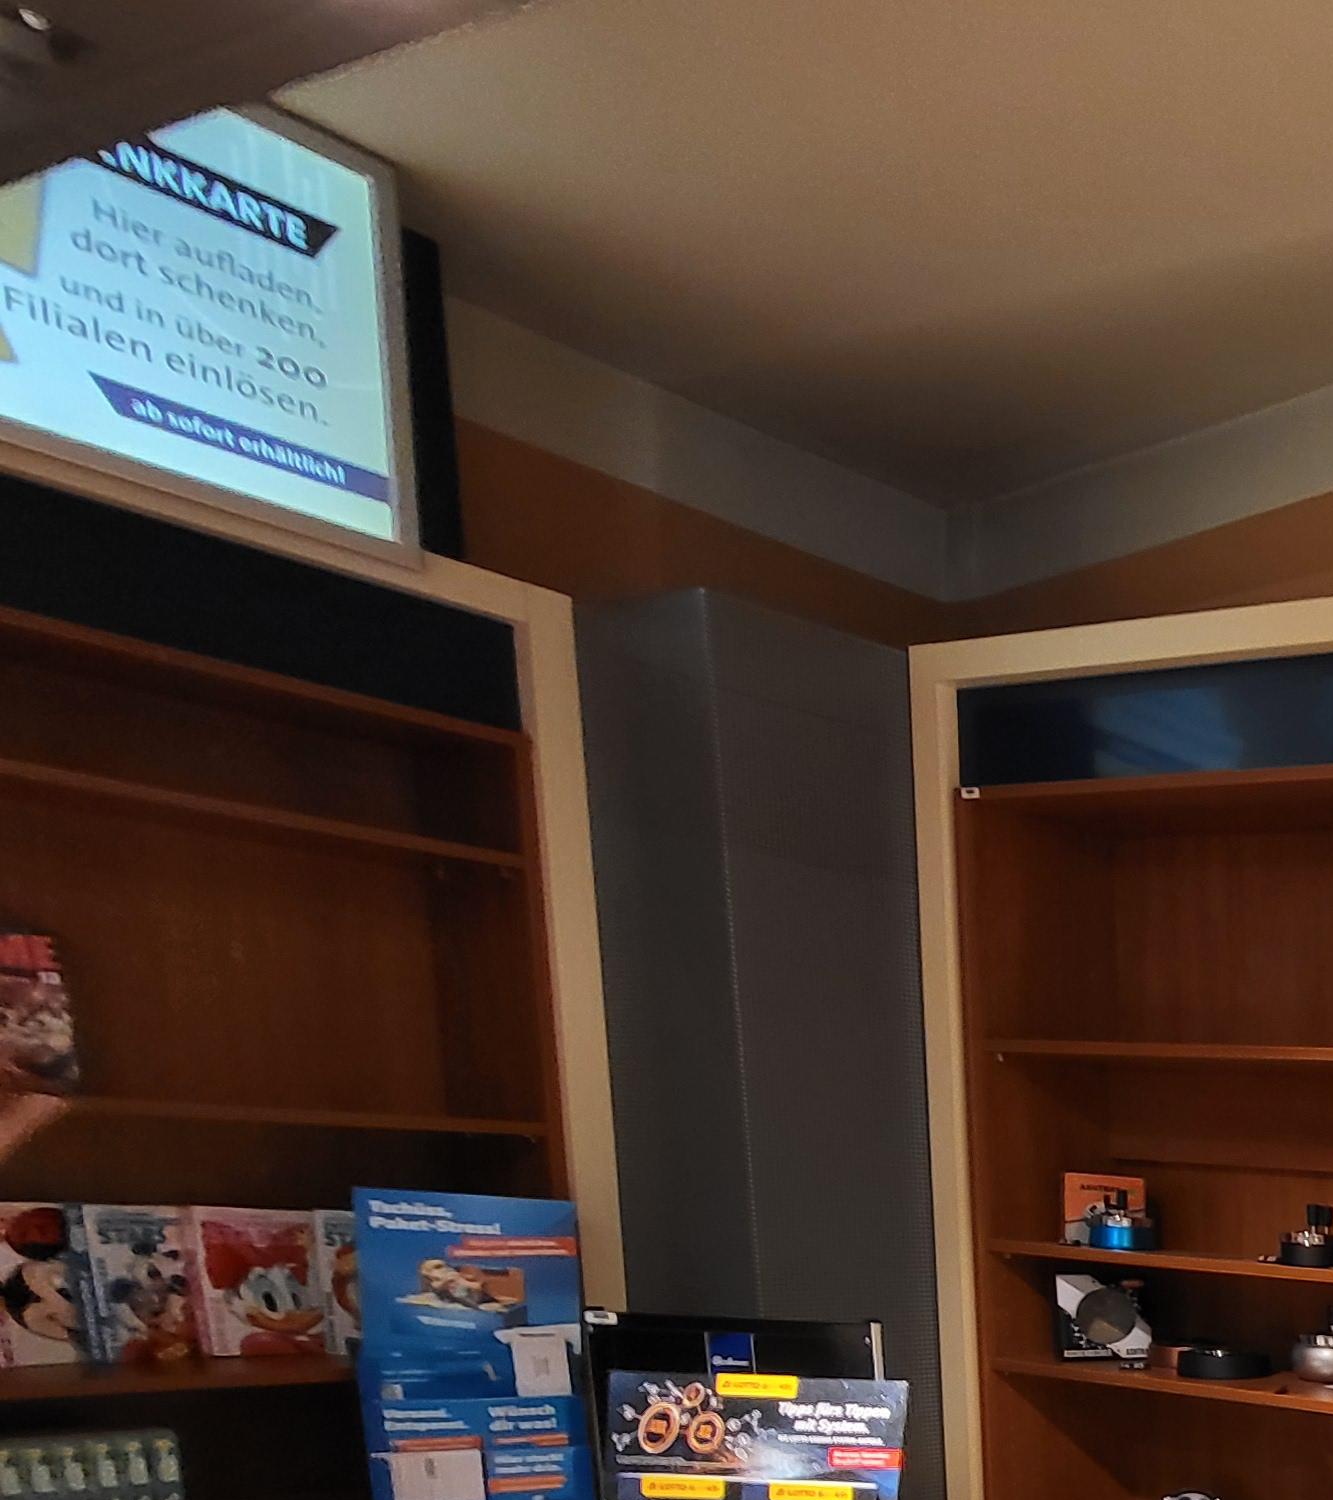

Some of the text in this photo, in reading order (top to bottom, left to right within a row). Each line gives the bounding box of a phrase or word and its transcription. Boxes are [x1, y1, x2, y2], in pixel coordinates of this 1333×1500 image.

[91, 196, 167, 248] Hier
[70, 227, 149, 277] dort
[1, 284, 331, 426] Filialen einlösen.
[59, 273, 327, 390] und in über 200
[130, 398, 347, 486] ab sofort erhältlich!
[778, 1401, 815, 1419] Tipps
[844, 1403, 891, 1422] Tippen
[793, 1419, 818, 1432] mit
